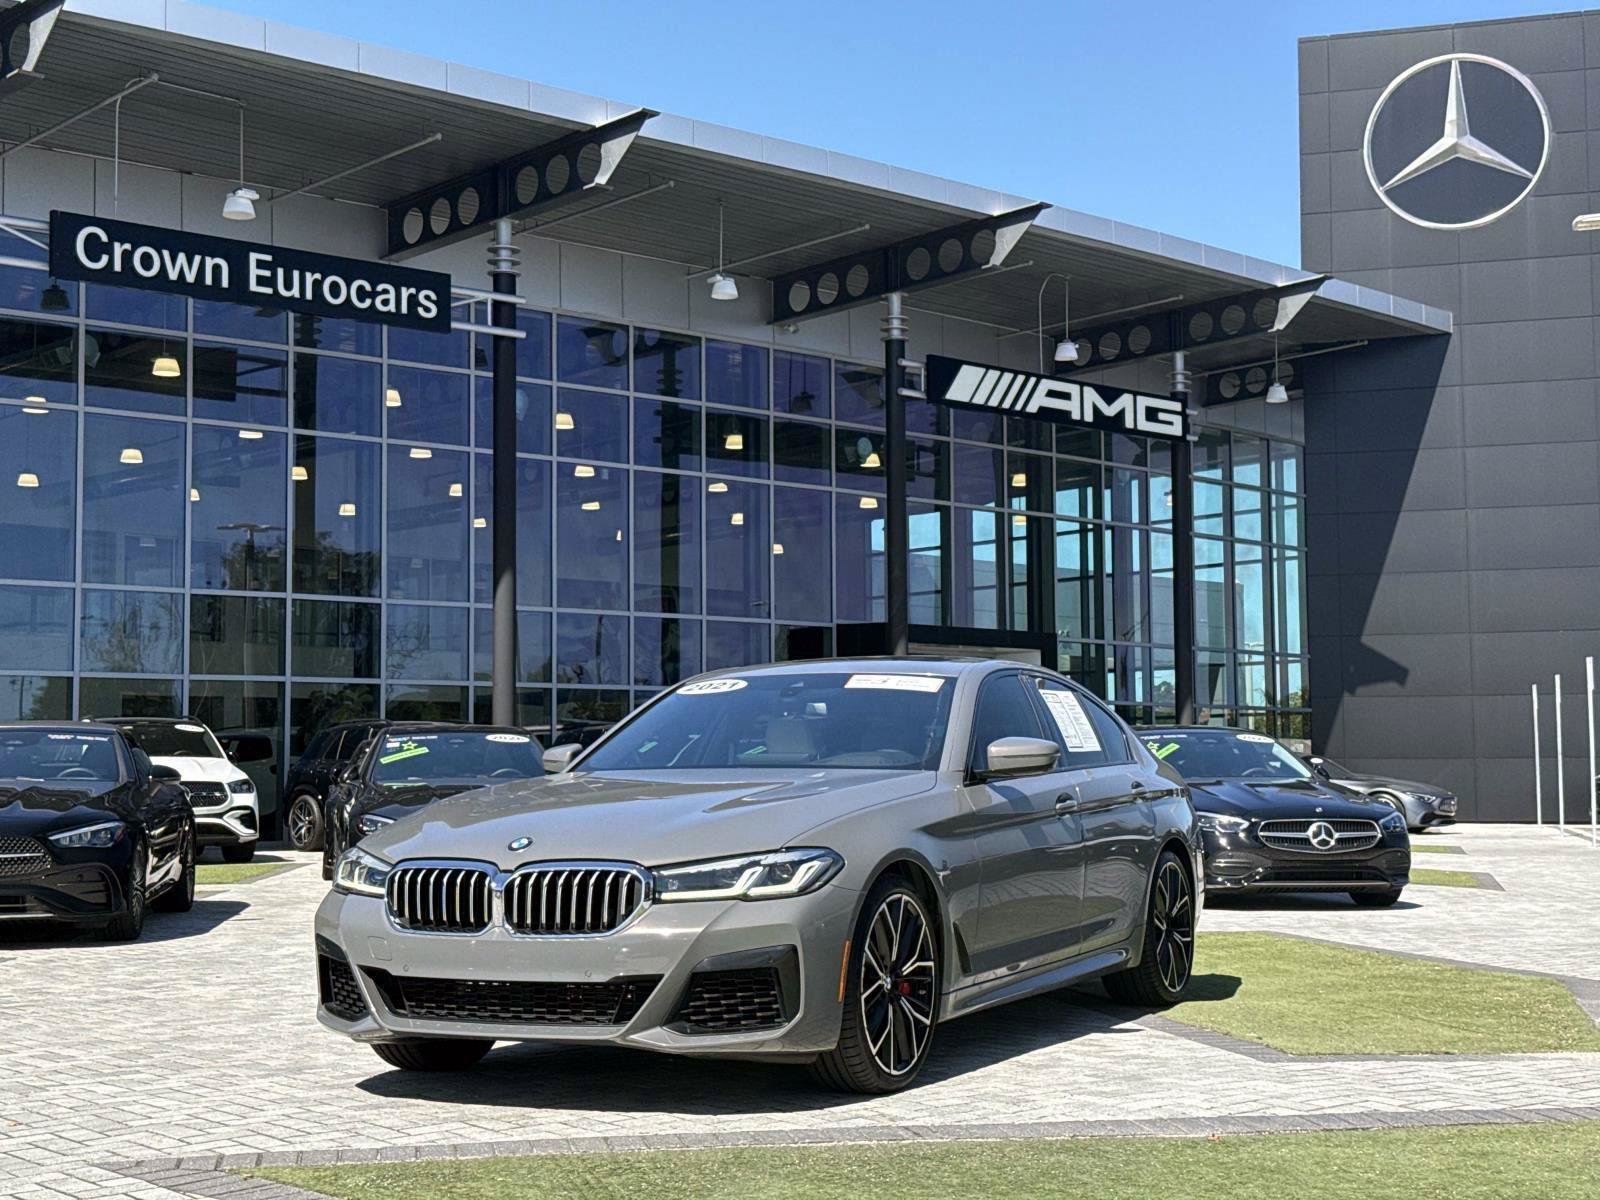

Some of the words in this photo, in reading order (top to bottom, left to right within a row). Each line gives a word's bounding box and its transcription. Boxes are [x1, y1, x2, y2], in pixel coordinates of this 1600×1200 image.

[76, 226, 229, 288] Crown
[249, 251, 438, 319] Eurocars
[1025, 378, 1183, 437] AMG
[683, 681, 740, 692] 2021
